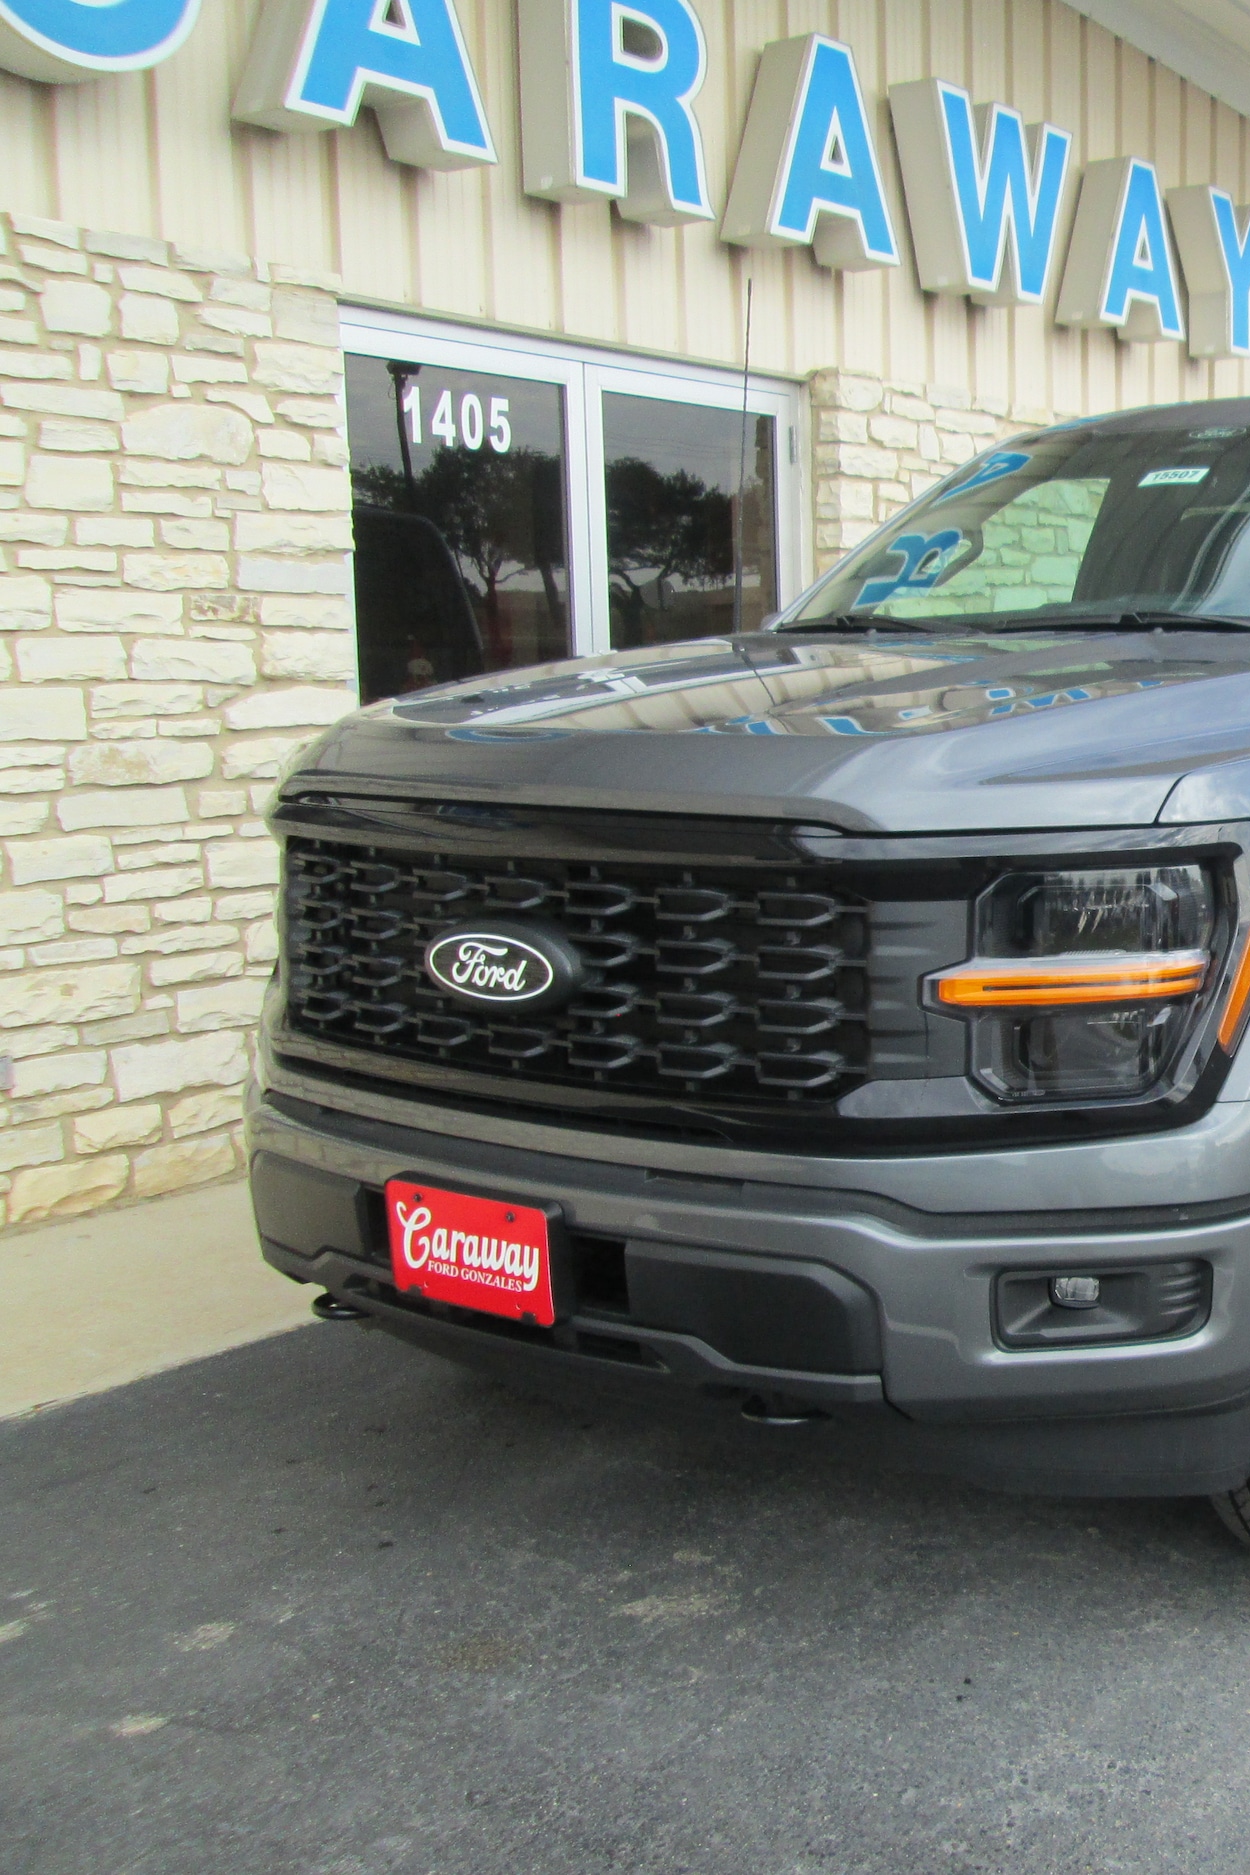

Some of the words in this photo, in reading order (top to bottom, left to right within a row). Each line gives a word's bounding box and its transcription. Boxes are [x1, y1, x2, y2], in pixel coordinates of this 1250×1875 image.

[402, 385, 512, 453] 1405
[452, 941, 527, 991] Ford
[396, 1201, 540, 1292] Caraway
[427, 1260, 459, 1278] FORD
[460, 1268, 523, 1293] GONZALES
